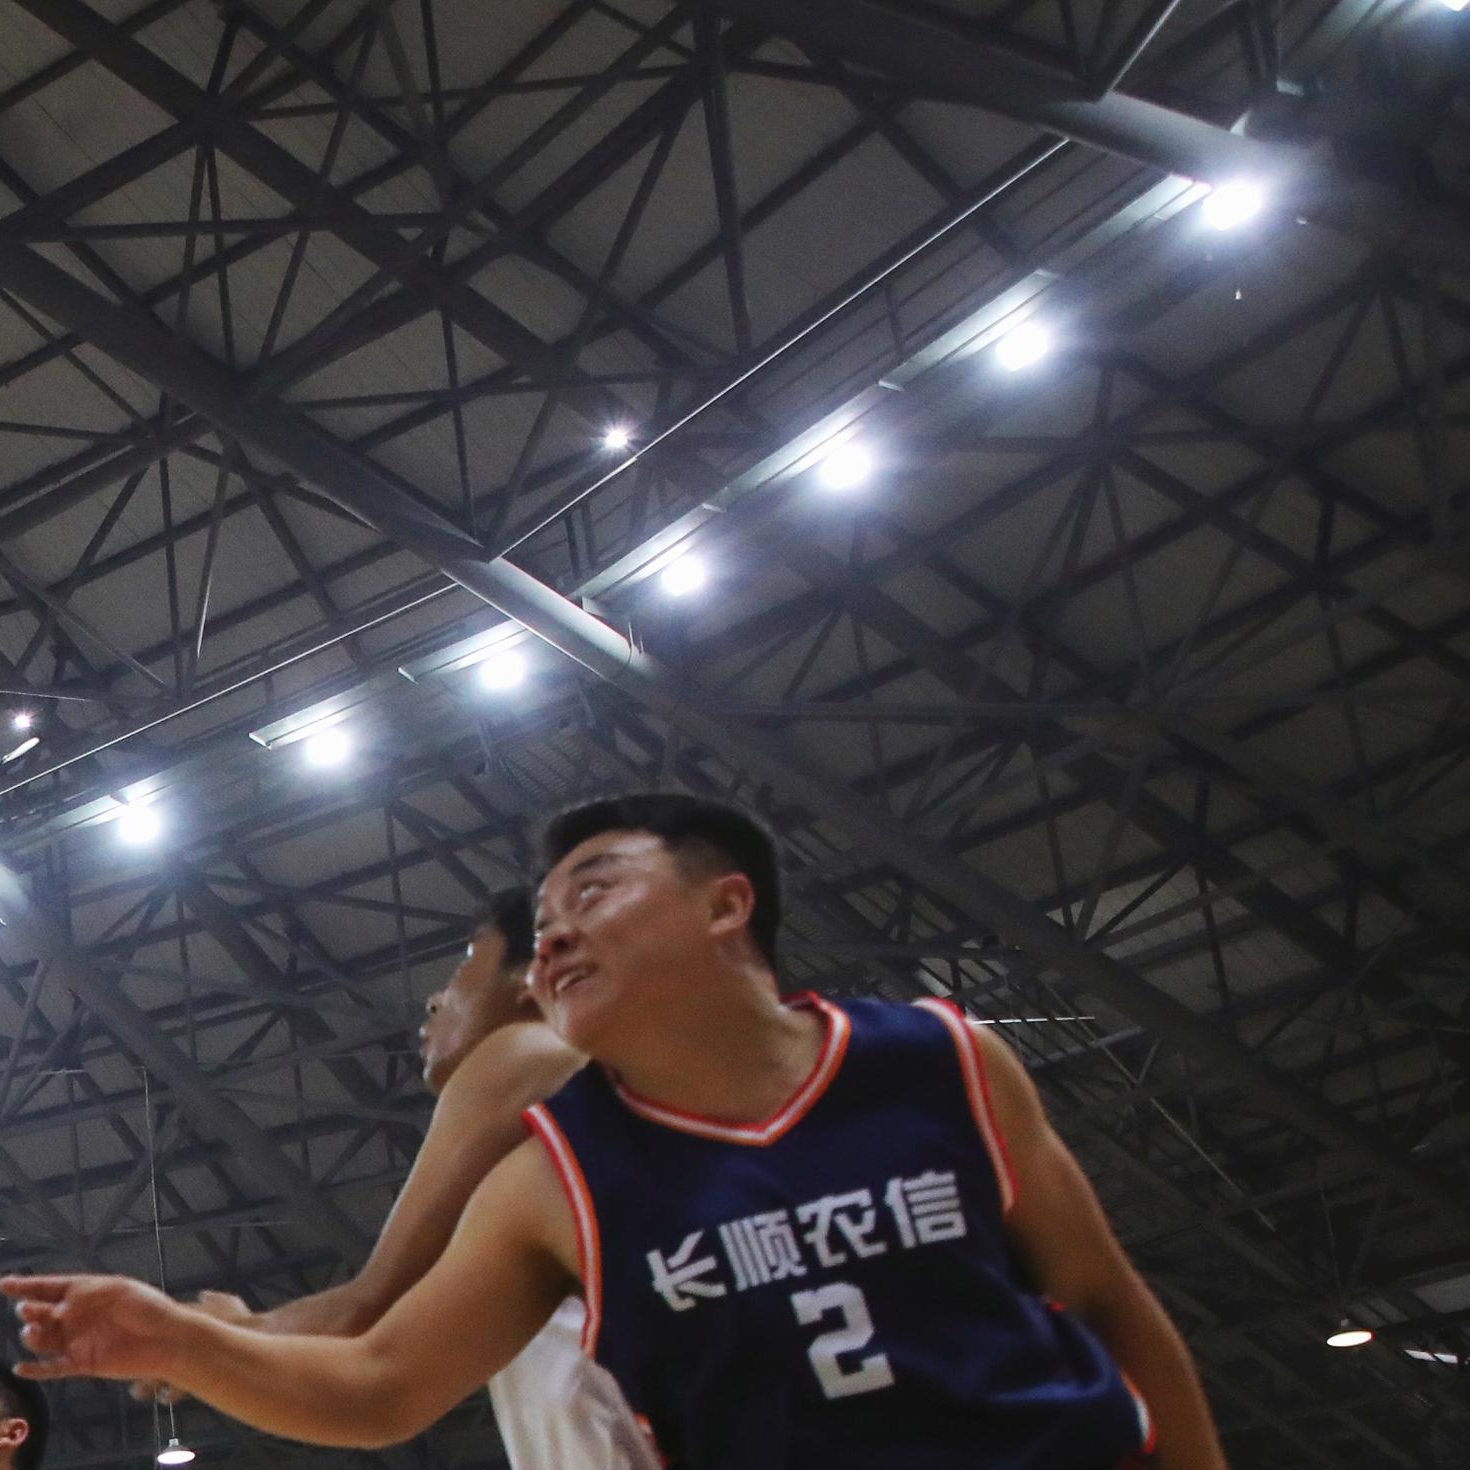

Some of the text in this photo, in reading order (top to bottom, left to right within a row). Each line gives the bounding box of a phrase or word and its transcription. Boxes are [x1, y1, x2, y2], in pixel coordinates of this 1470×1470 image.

[648, 1169, 967, 1313] 长顺农信
[790, 1280, 895, 1399] 2
